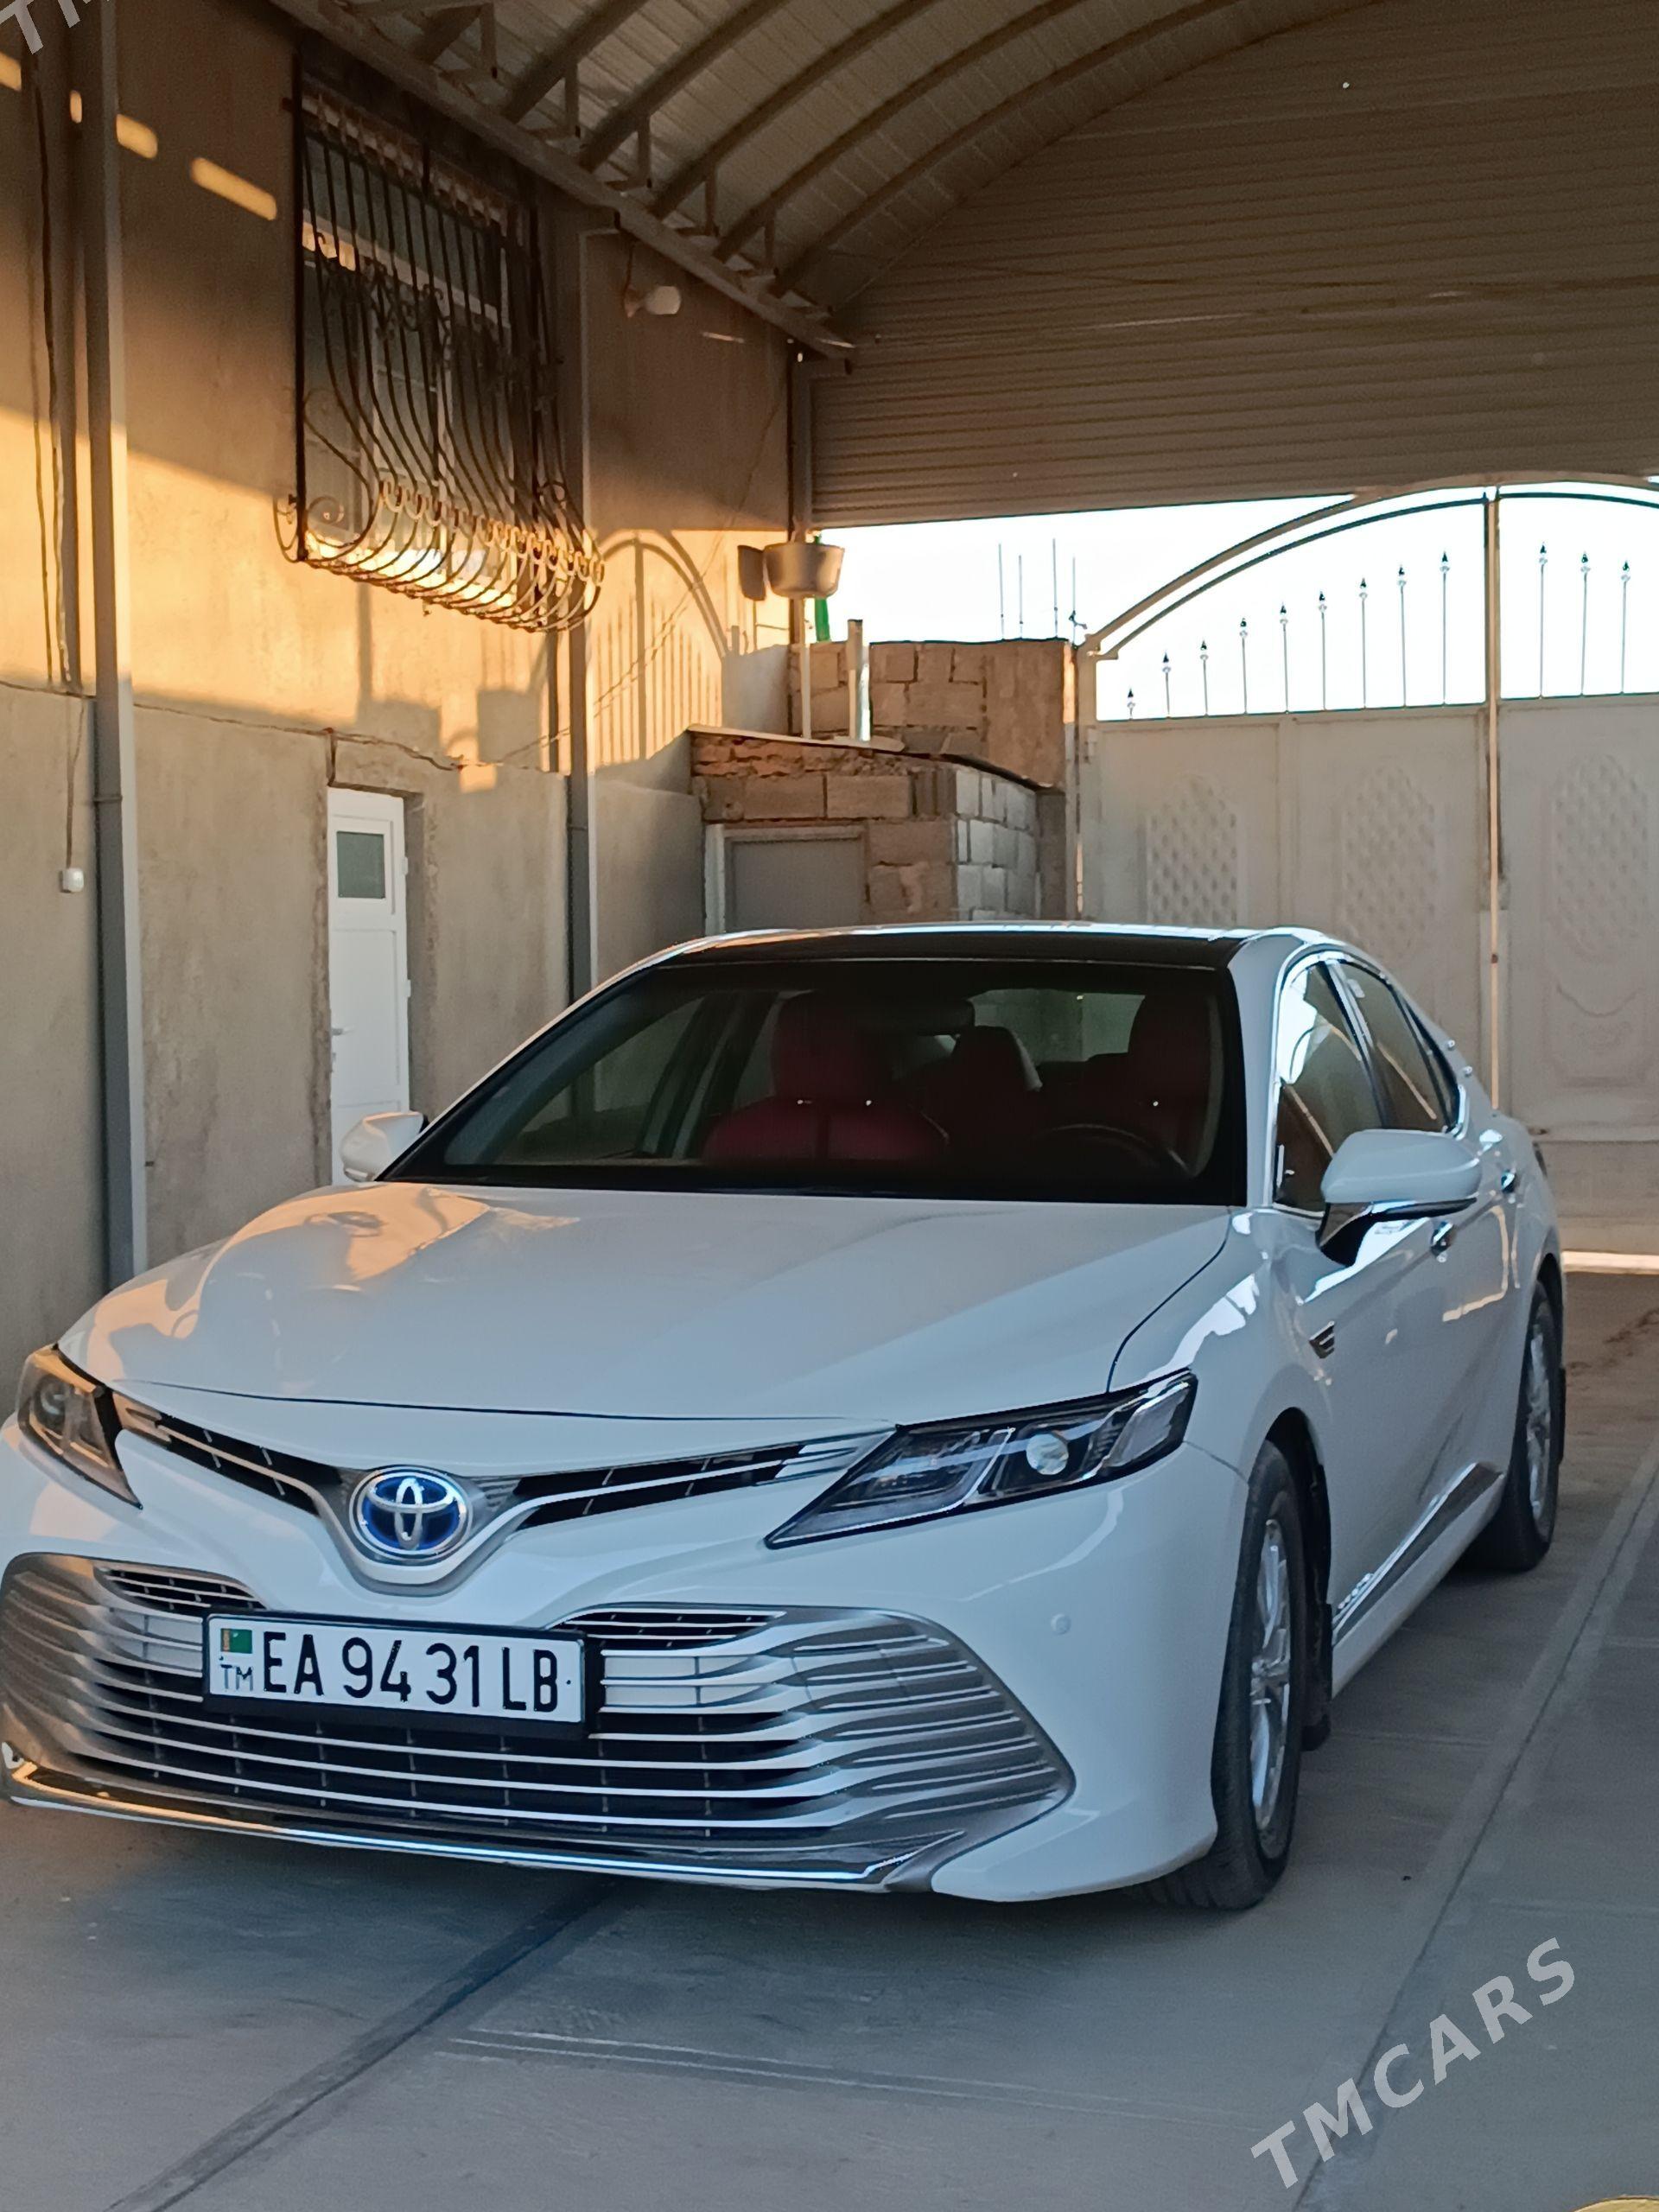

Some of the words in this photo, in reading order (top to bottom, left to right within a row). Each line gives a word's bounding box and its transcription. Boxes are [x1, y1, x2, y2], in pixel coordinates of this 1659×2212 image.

[219, 1663, 254, 1691] TM
[263, 1630, 324, 1695] EA
[501, 1646, 558, 1712] LB
